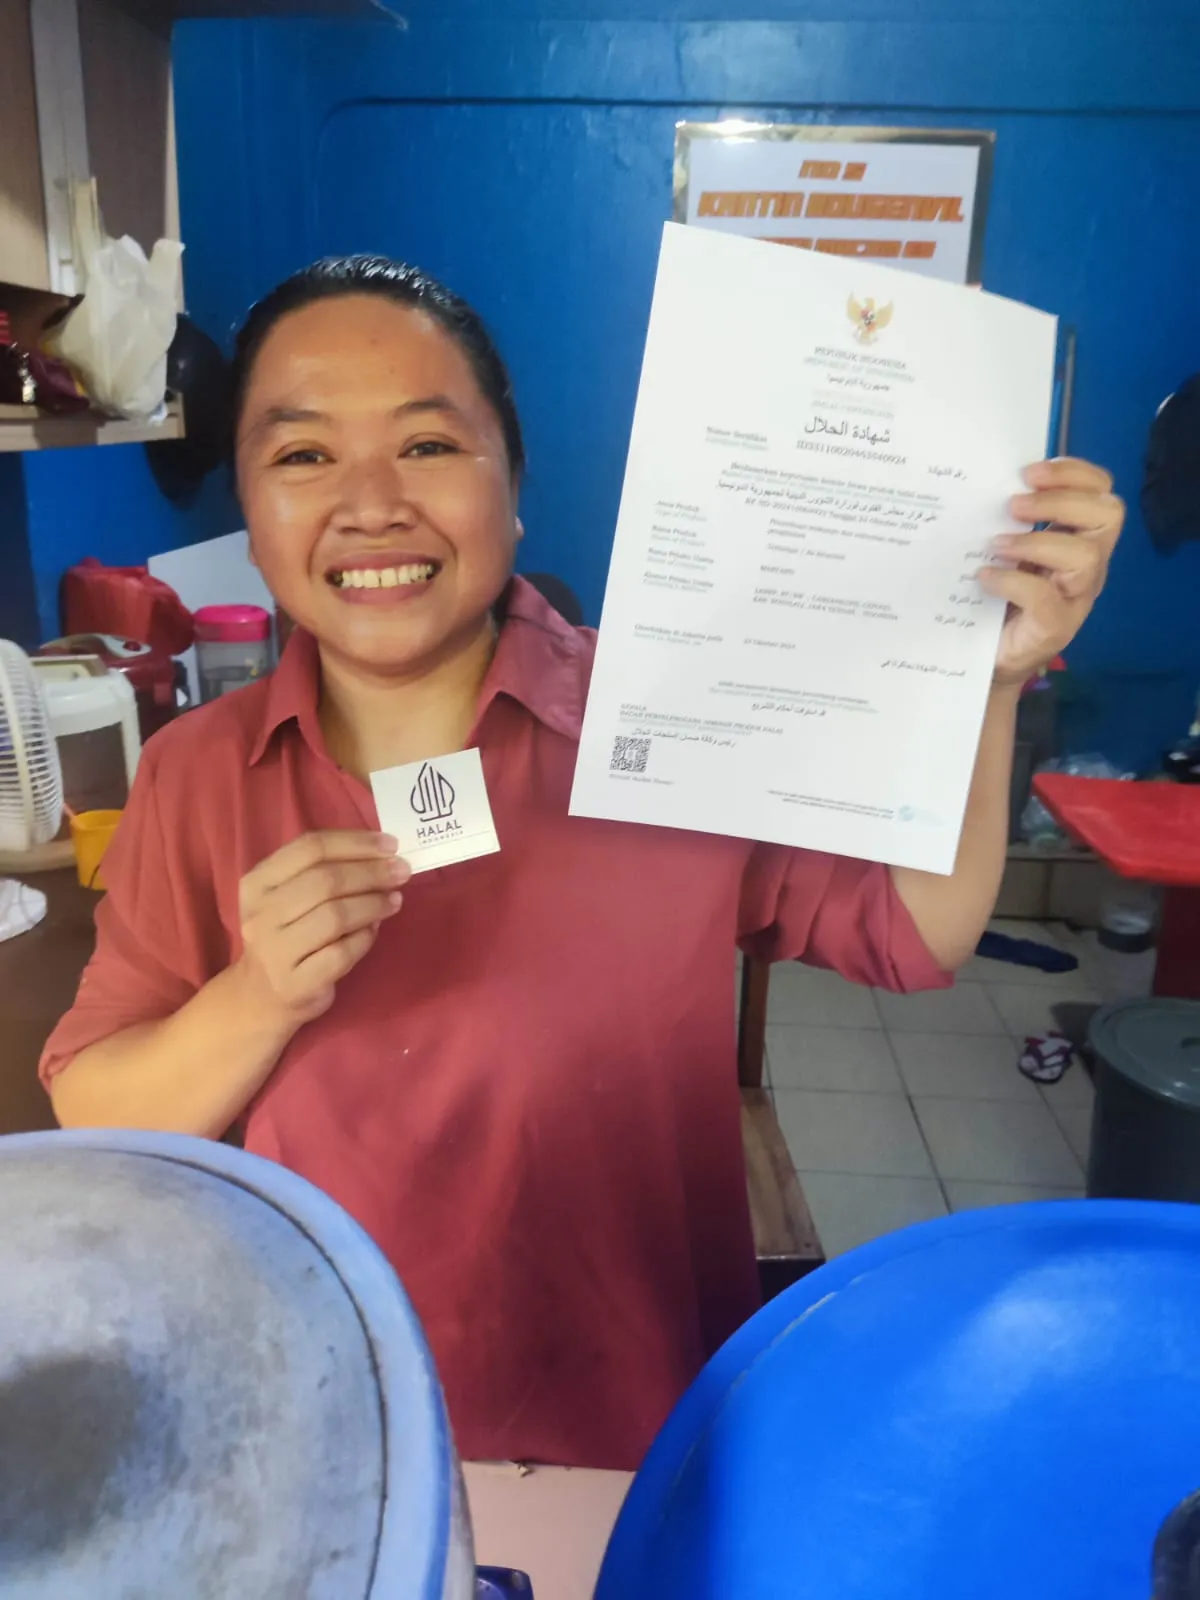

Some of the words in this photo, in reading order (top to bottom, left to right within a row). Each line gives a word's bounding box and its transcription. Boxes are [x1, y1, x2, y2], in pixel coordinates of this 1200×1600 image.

[804, 415, 849, 436] الحلال
[851, 424, 891, 446] شهادة
[416, 819, 462, 839] HALAL
